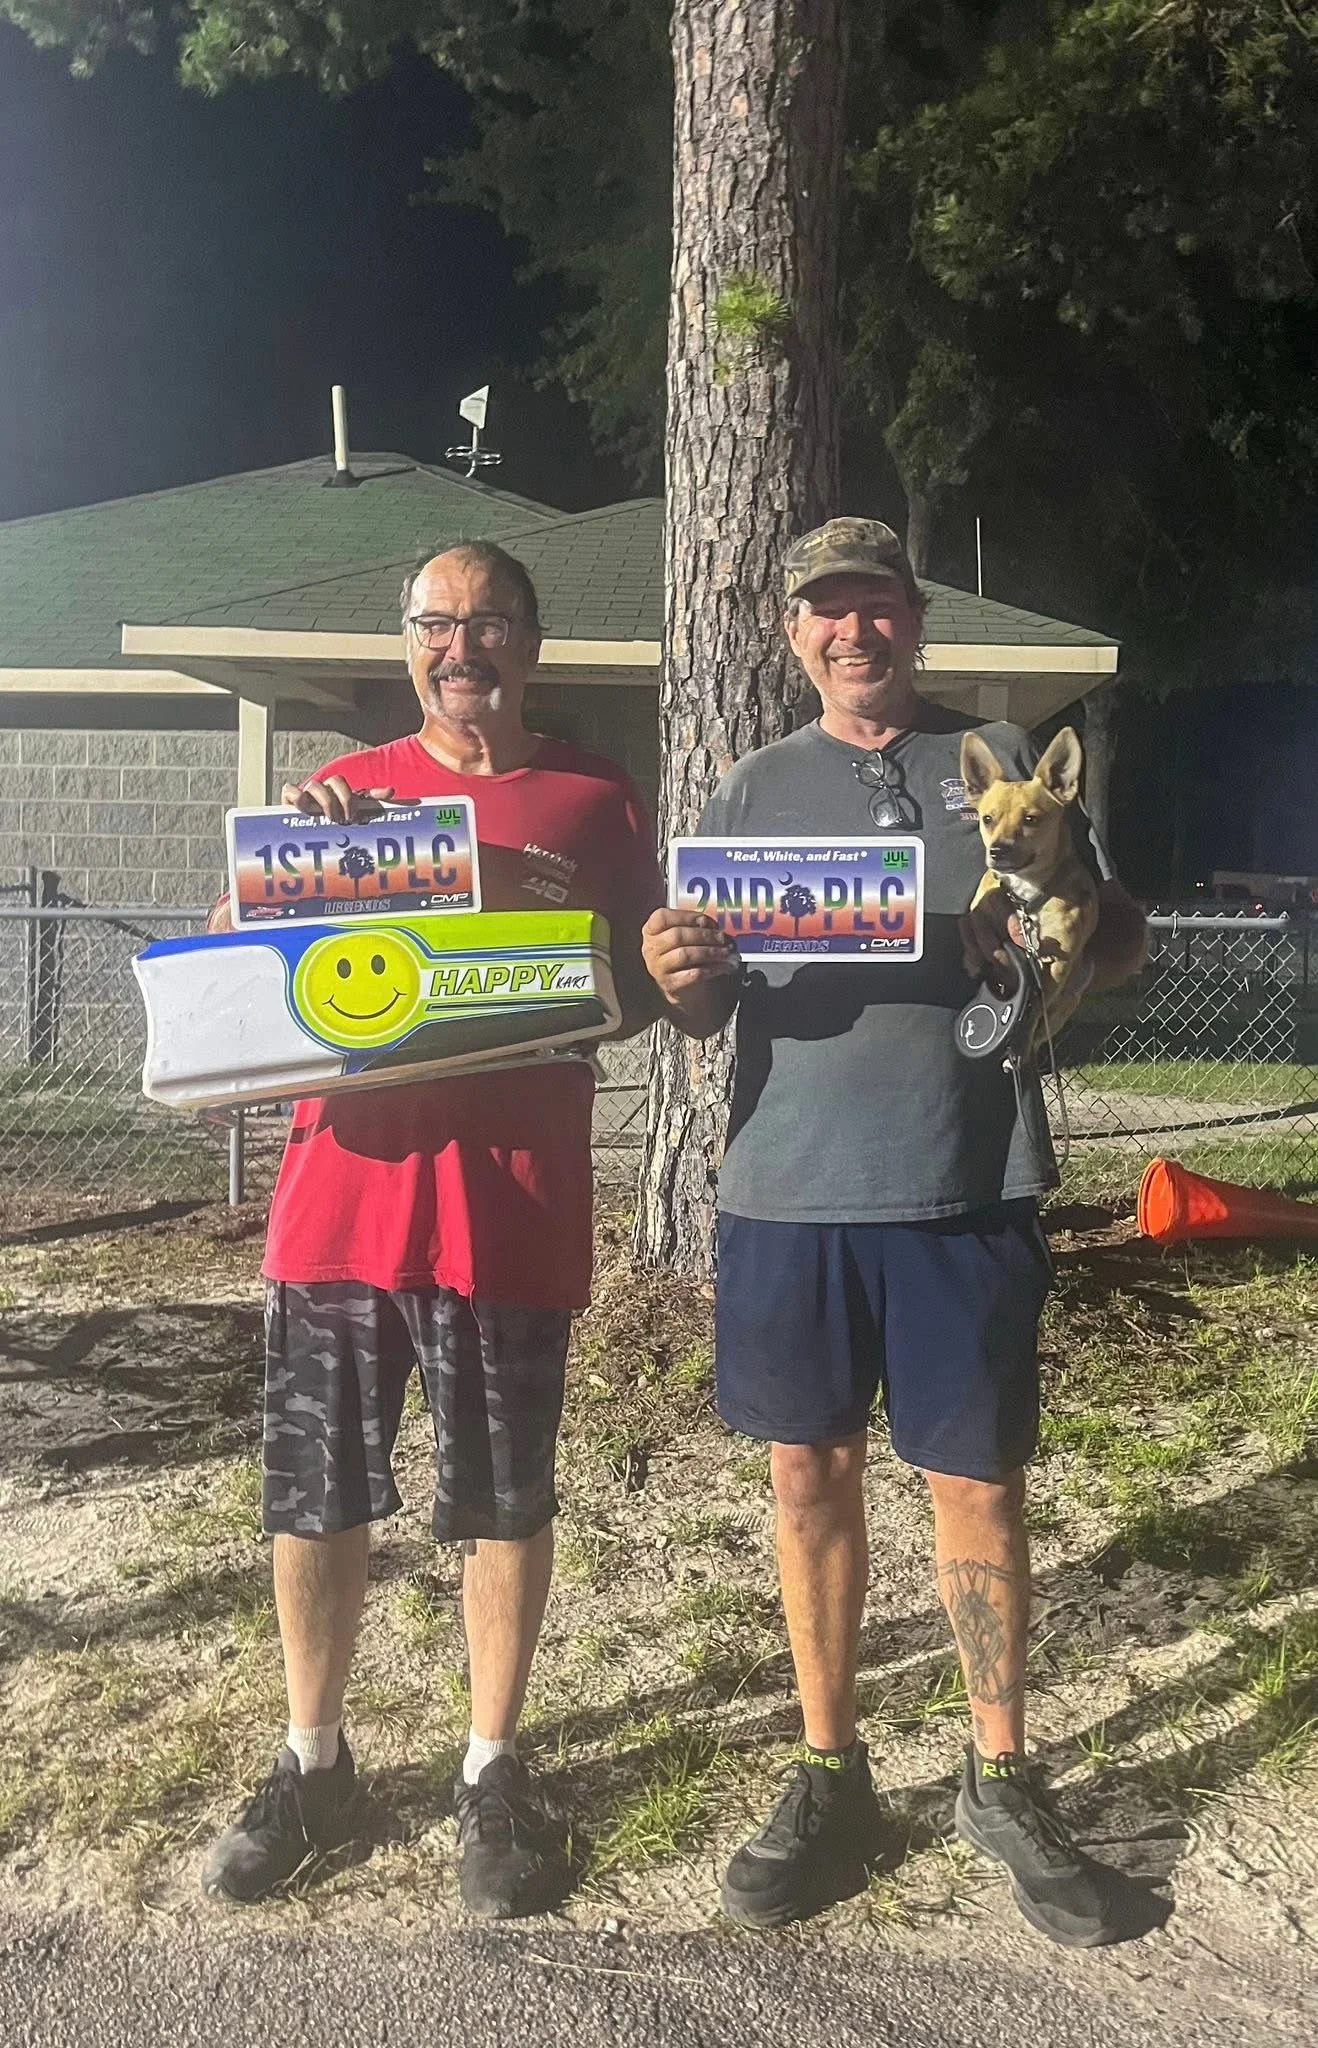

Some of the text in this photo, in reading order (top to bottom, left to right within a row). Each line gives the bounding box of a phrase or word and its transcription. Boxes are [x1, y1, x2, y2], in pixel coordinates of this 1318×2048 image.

[290, 815, 317, 828] Red,
[386, 811, 413, 822] Fast
[435, 808, 461, 821] JUL
[733, 851, 859, 863] Red, White, and Fast
[884, 851, 909, 863] JUL
[255, 834, 457, 897] 1ST PLC
[430, 892, 469, 904] CMP
[686, 876, 905, 931] 2ND PLC
[324, 898, 391, 914] LEGENDS
[762, 938, 831, 953] LEGENDS
[870, 938, 910, 948] CMP
[429, 963, 591, 996] HAPPY KART
